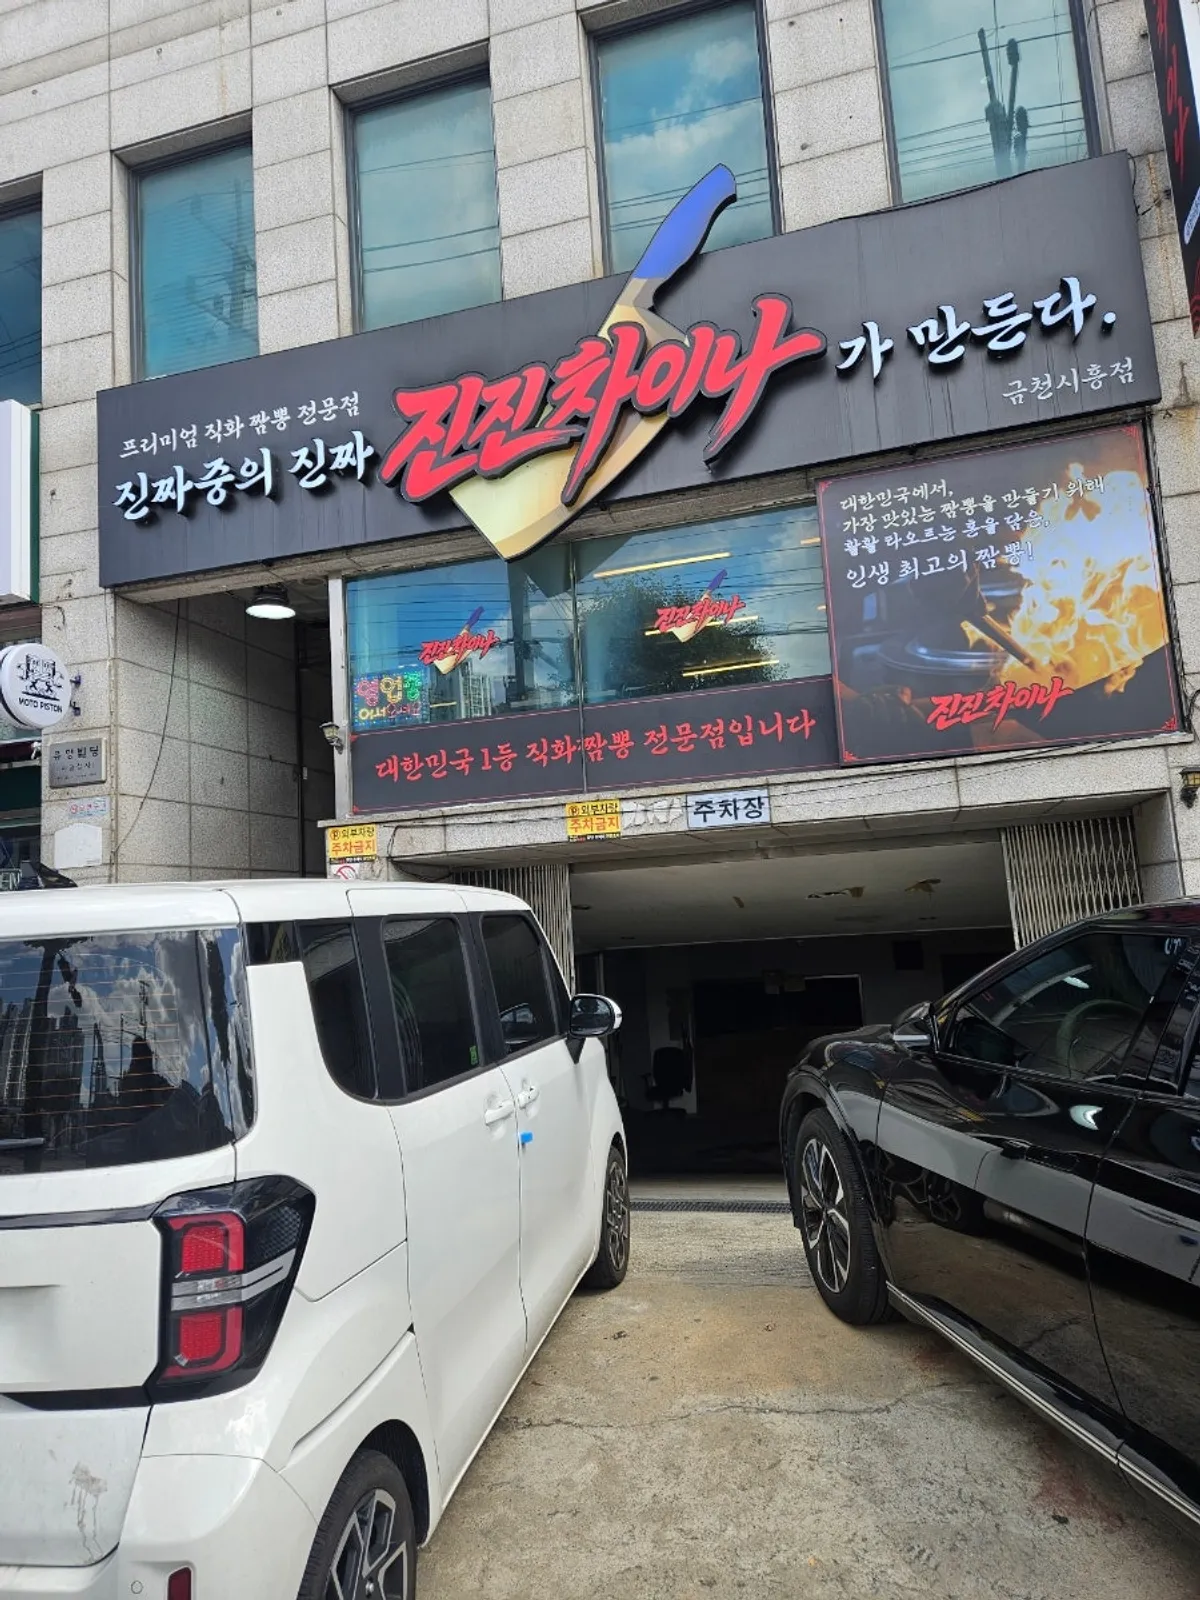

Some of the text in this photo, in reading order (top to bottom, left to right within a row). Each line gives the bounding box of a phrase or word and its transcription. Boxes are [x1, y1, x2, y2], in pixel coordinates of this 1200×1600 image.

[113, 277, 1117, 520] 진짜중의 진짜 진진차이나 가 만든다.
[1002, 356, 1134, 405] 금천시흥점
[120, 391, 360, 458] 프리미엄 직화 짬뽕 전문점
[840, 479, 955, 513] 대한민국에서,
[842, 475, 1105, 535] 가장 맛있는 짬뽕을 만들기 위해
[843, 510, 1051, 557] 활활 타오르는 혼을 담은,
[846, 561, 891, 589] 인생
[899, 549, 969, 580] 최고의
[654, 594, 746, 633] 진진차이나
[418, 630, 500, 666] 진진차이나
[19, 697, 63, 714] MOTO PISTON
[356, 672, 421, 707] 영업중
[926, 676, 1075, 732] 진진차이나
[375, 708, 817, 783] 대한민국 1등 직화 짬뽕 전문점입니다
[569, 816, 619, 832] 주차금지
[693, 796, 765, 823] 주차장
[332, 840, 375, 855] 주차금지
[342, 827, 374, 839] 외부차량
